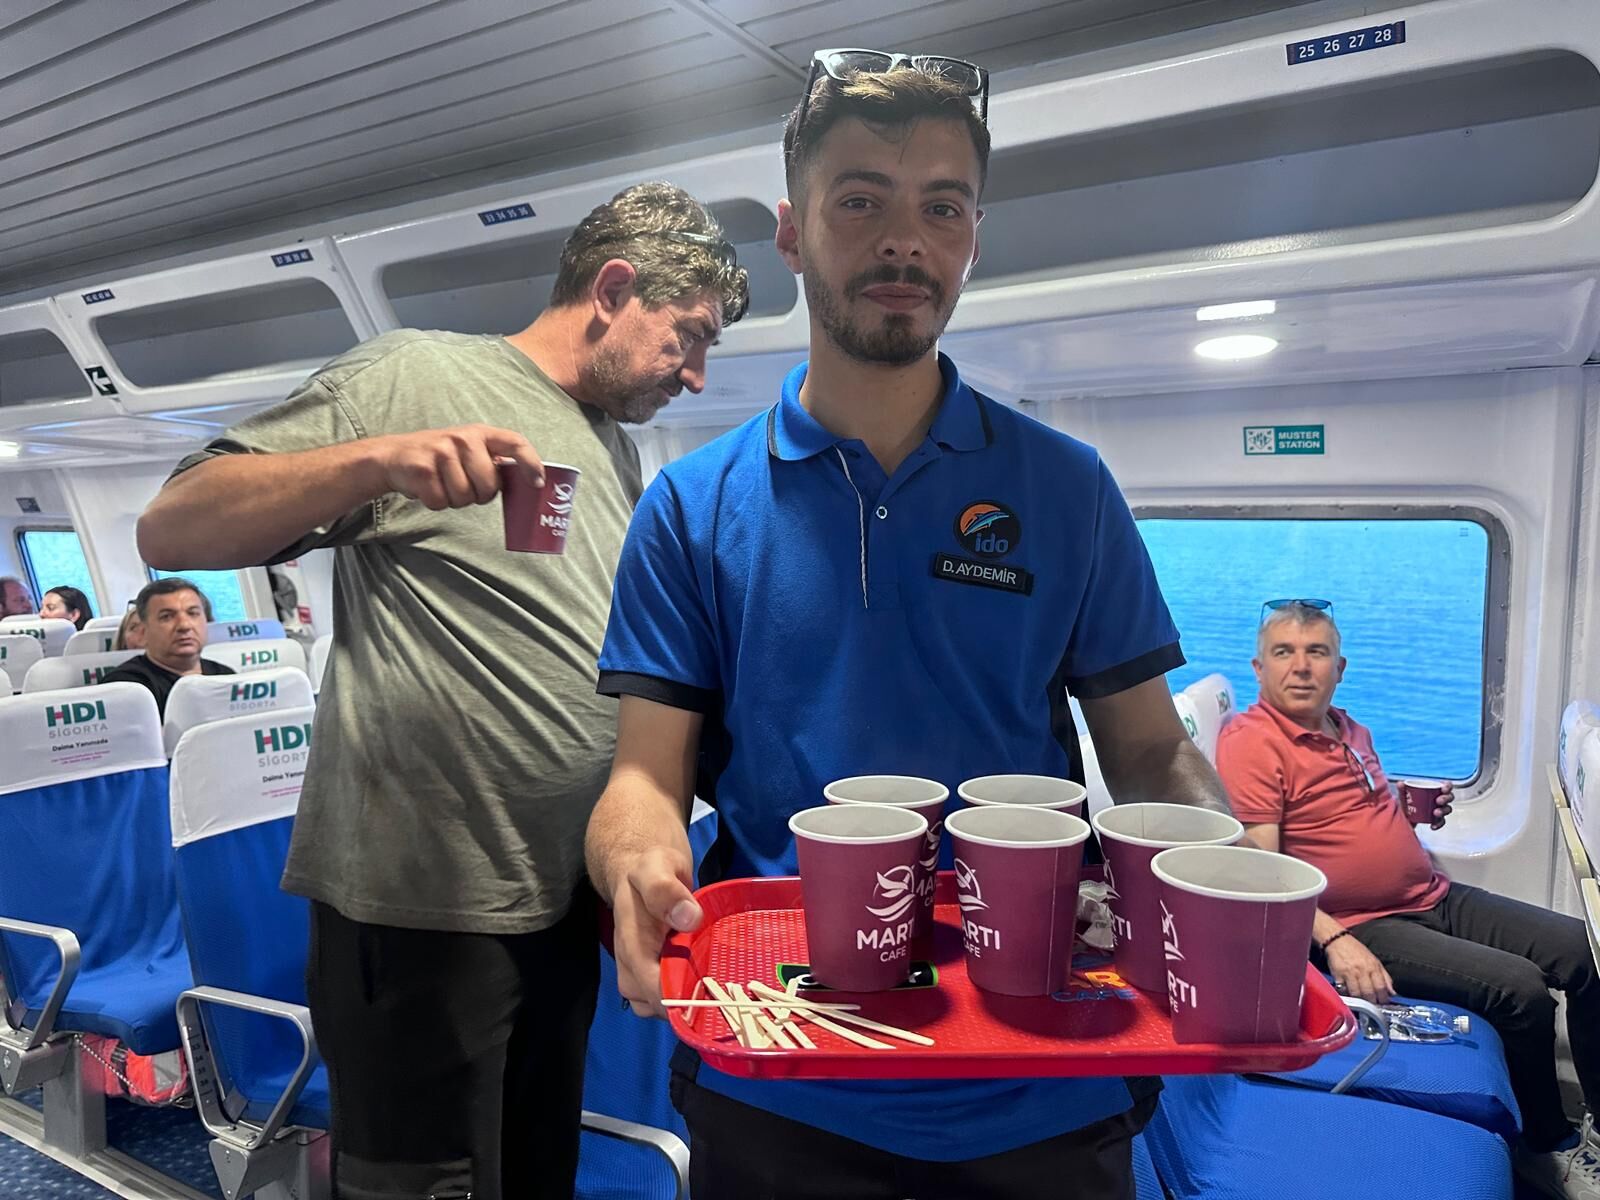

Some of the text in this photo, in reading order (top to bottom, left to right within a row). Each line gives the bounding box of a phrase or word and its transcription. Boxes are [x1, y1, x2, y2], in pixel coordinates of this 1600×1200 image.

[1298, 28, 1392, 59] 25 26 27 28
[1278, 431, 1320, 440] MUSTER
[1278, 440, 1321, 449] STATION
[227, 623, 259, 639] HDI
[241, 649, 279, 667] HDI
[230, 680, 277, 702] HDI
[45, 700, 107, 728] HDI
[258, 751, 307, 768] SİGORT
[856, 915, 914, 950] MART
[961, 914, 1001, 950] ARTI
[879, 945, 907, 962] CAFE
[1167, 969, 1197, 1008] RTI
